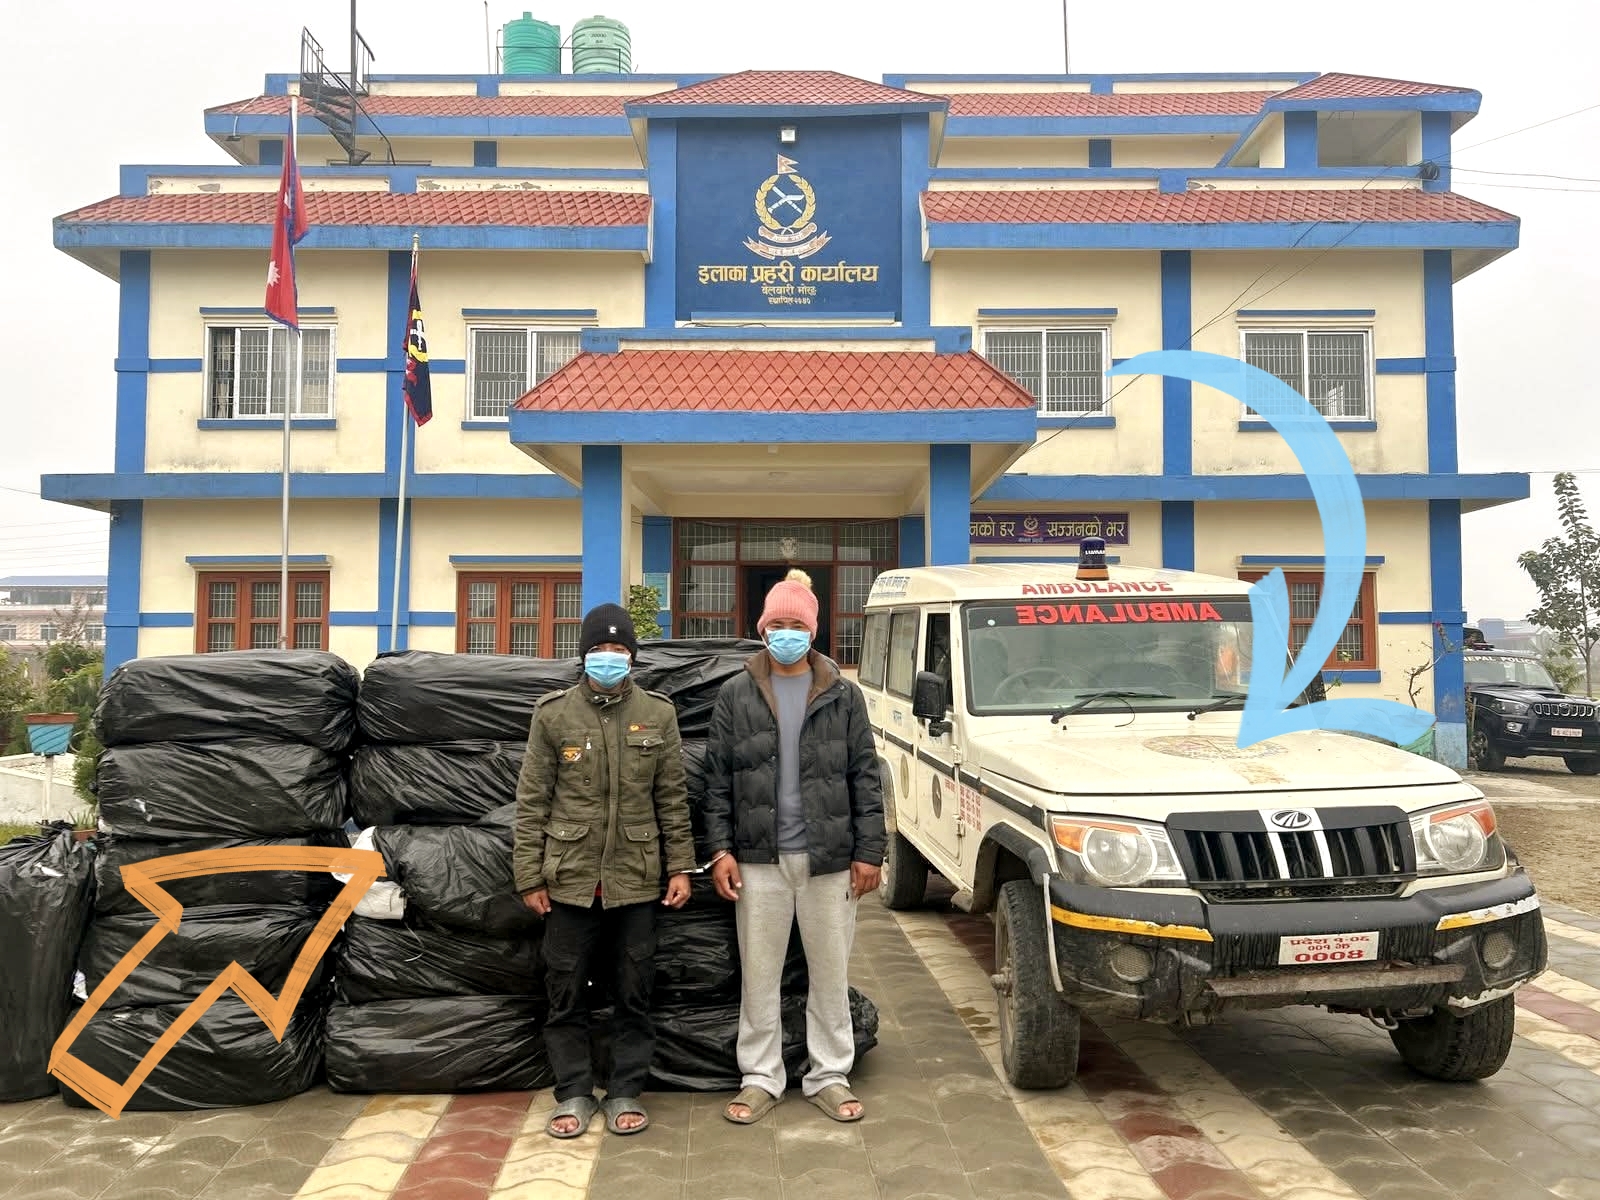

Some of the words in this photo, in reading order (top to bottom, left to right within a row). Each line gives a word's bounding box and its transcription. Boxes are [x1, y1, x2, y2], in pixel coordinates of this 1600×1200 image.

[698, 265, 748, 283] इलाका
[750, 260, 795, 284] प्रहरी
[800, 261, 879, 282] कार्यालय
[999, 521, 1016, 537] डर
[1046, 516, 1104, 537] सज्जनको
[1021, 581, 1174, 595] AMBULANCE
